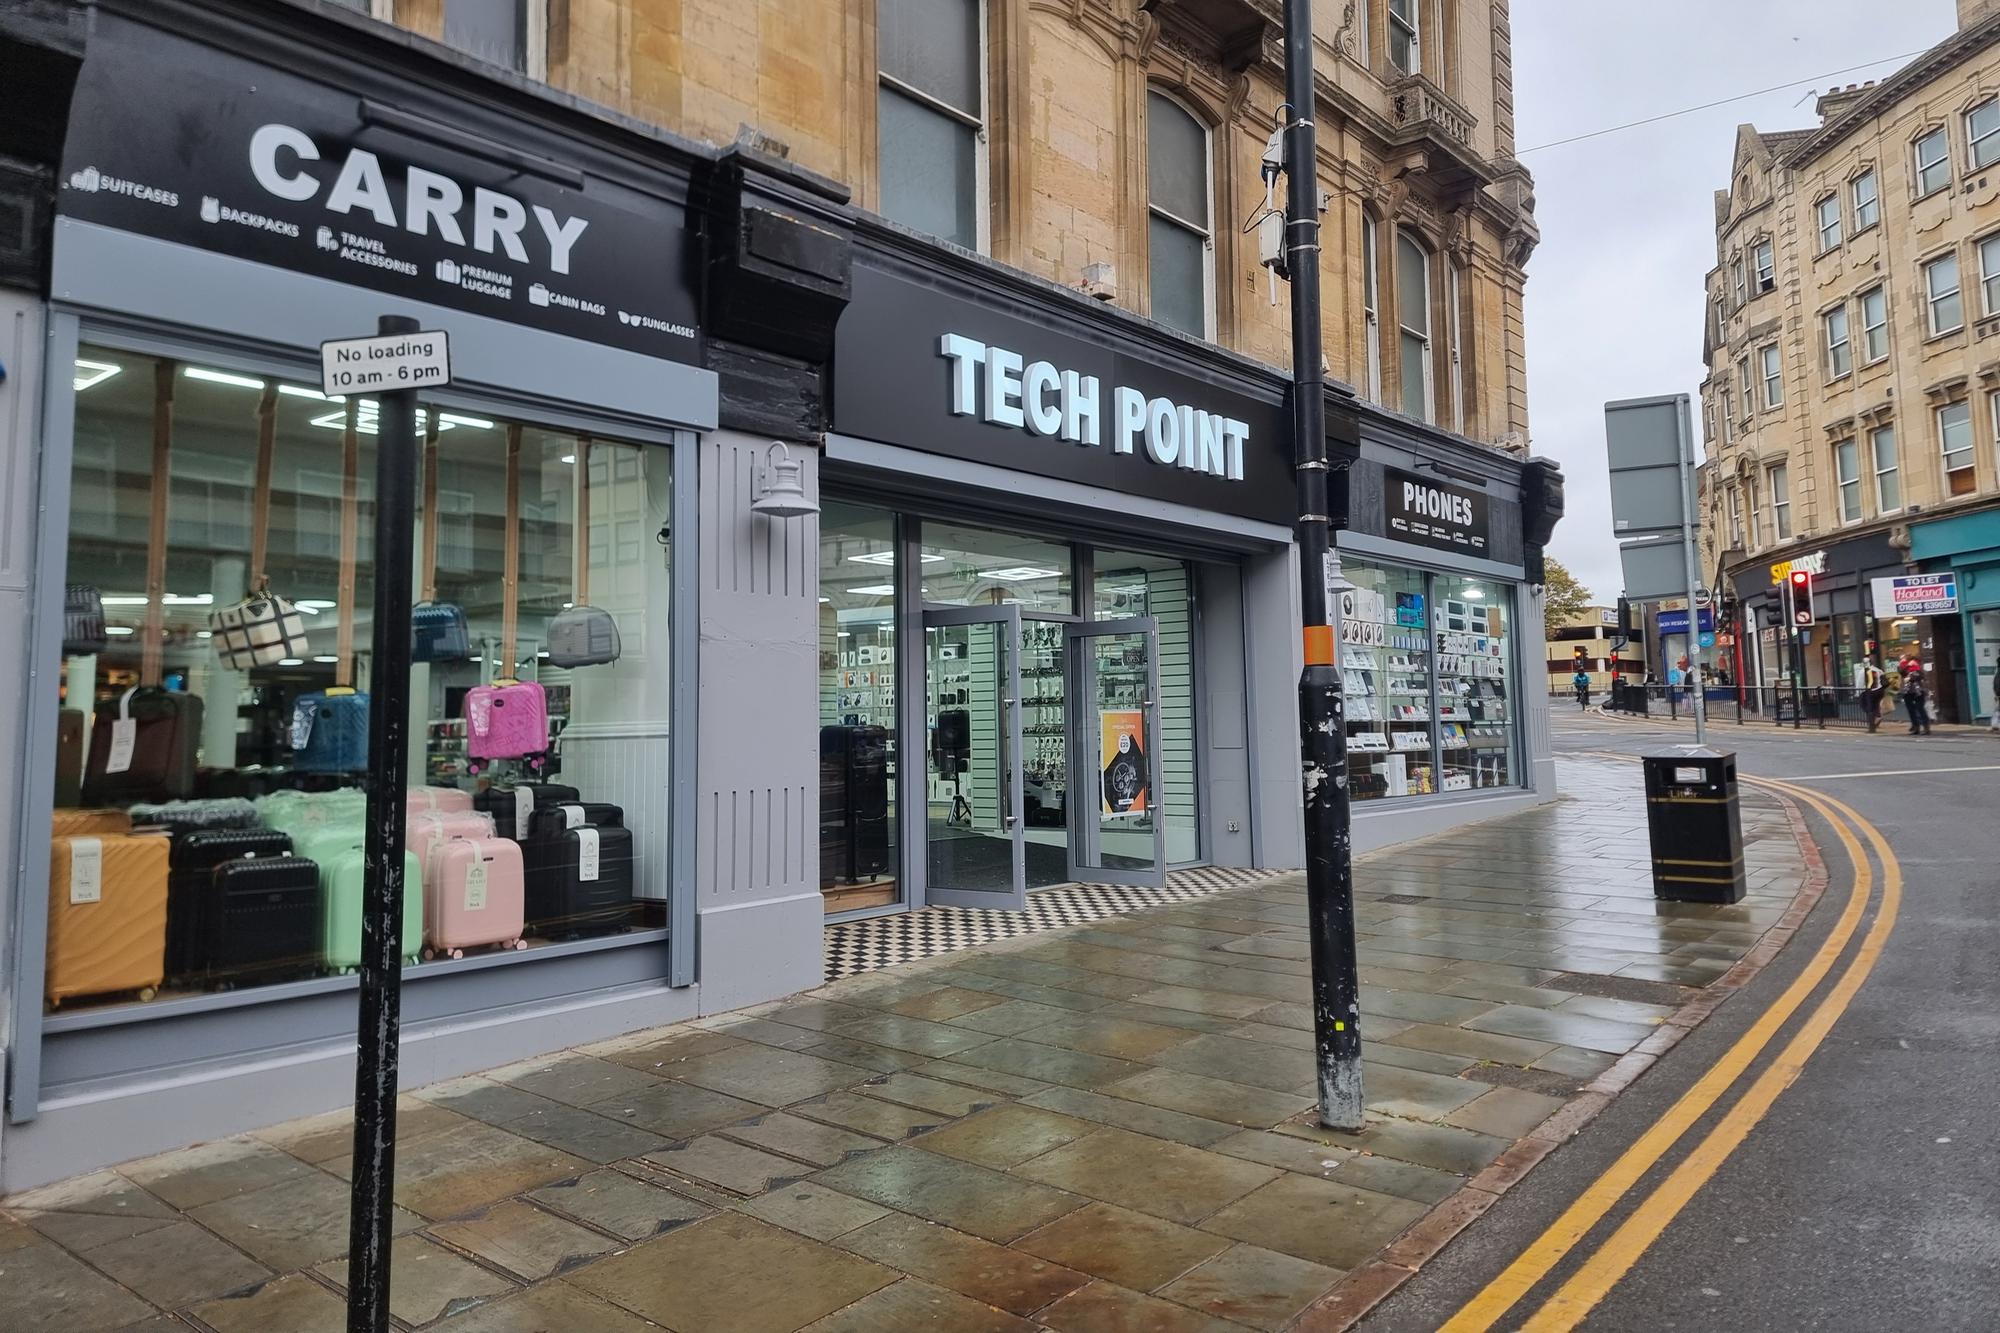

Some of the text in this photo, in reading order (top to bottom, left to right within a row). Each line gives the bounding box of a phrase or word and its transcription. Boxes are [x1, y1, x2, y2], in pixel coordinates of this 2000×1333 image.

[100, 175, 179, 207] SUITCASES
[250, 123, 589, 275] CARRY
[220, 206, 300, 238] BACKPACKS
[340, 231, 387, 255] TRAVEL
[340, 247, 418, 277] ACCESSORIES
[461, 263, 513, 287] PREMIUM
[461, 277, 512, 300] LUGGAGE
[549, 292, 606, 316] CABIN BAGS
[641, 316, 695, 339] SUNGLASSES
[337, 342, 433, 363] No loading
[332, 372, 352, 387] 10
[357, 371, 382, 385] am
[398, 366, 408, 380] 6
[413, 366, 440, 380] pm
[941, 333, 1249, 481] TECH POINT
[1403, 481, 1473, 527] PHONES
[1906, 576, 1940, 586] TO LET
